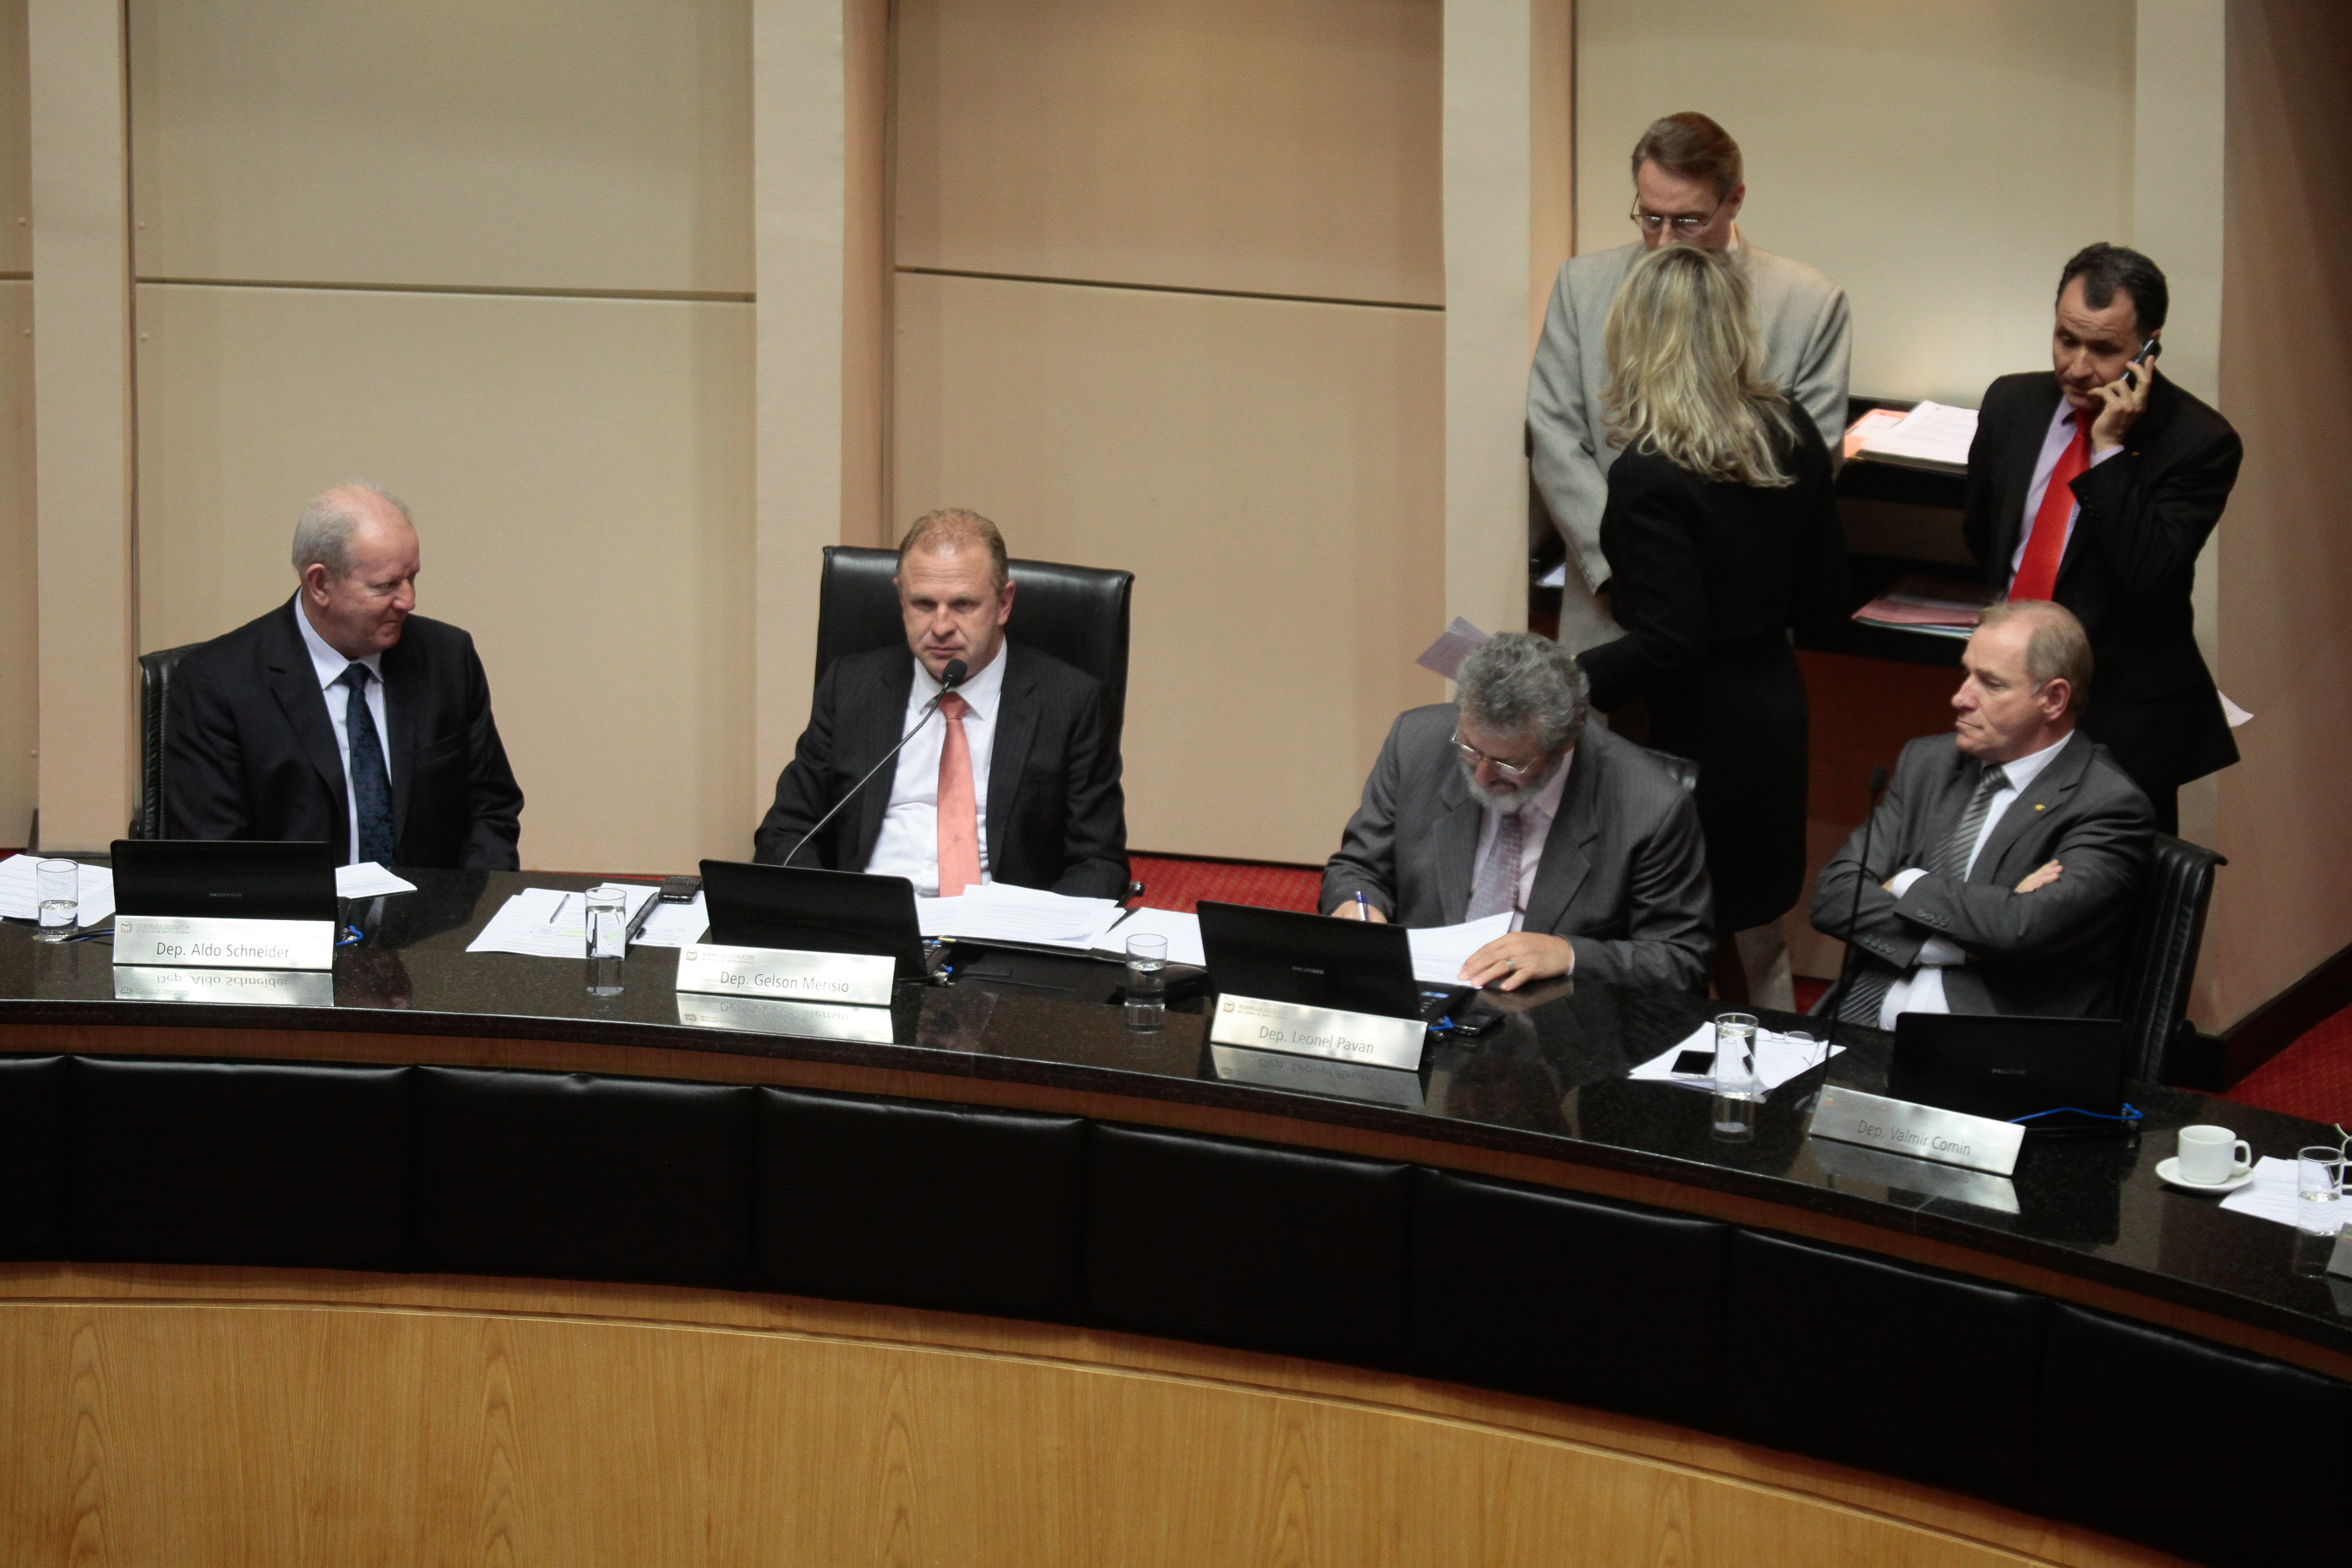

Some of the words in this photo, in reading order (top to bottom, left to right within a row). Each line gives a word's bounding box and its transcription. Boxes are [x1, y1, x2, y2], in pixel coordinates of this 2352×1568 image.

[156, 942, 187, 959] Dep.
[191, 942, 221, 957] Aldo
[226, 944, 290, 959] Schneider
[721, 971, 749, 988] Dep.
[754, 973, 798, 989] Gelson
[803, 977, 849, 993] Merisio
[1260, 1026, 1287, 1044] Dep.
[1293, 1030, 1334, 1048] Leonel
[1337, 1037, 1375, 1054] Pavan
[1858, 1119, 1885, 1140] Dep.
[1891, 1126, 1930, 1146] Valmir
[1931, 1135, 1971, 1157] Comin
